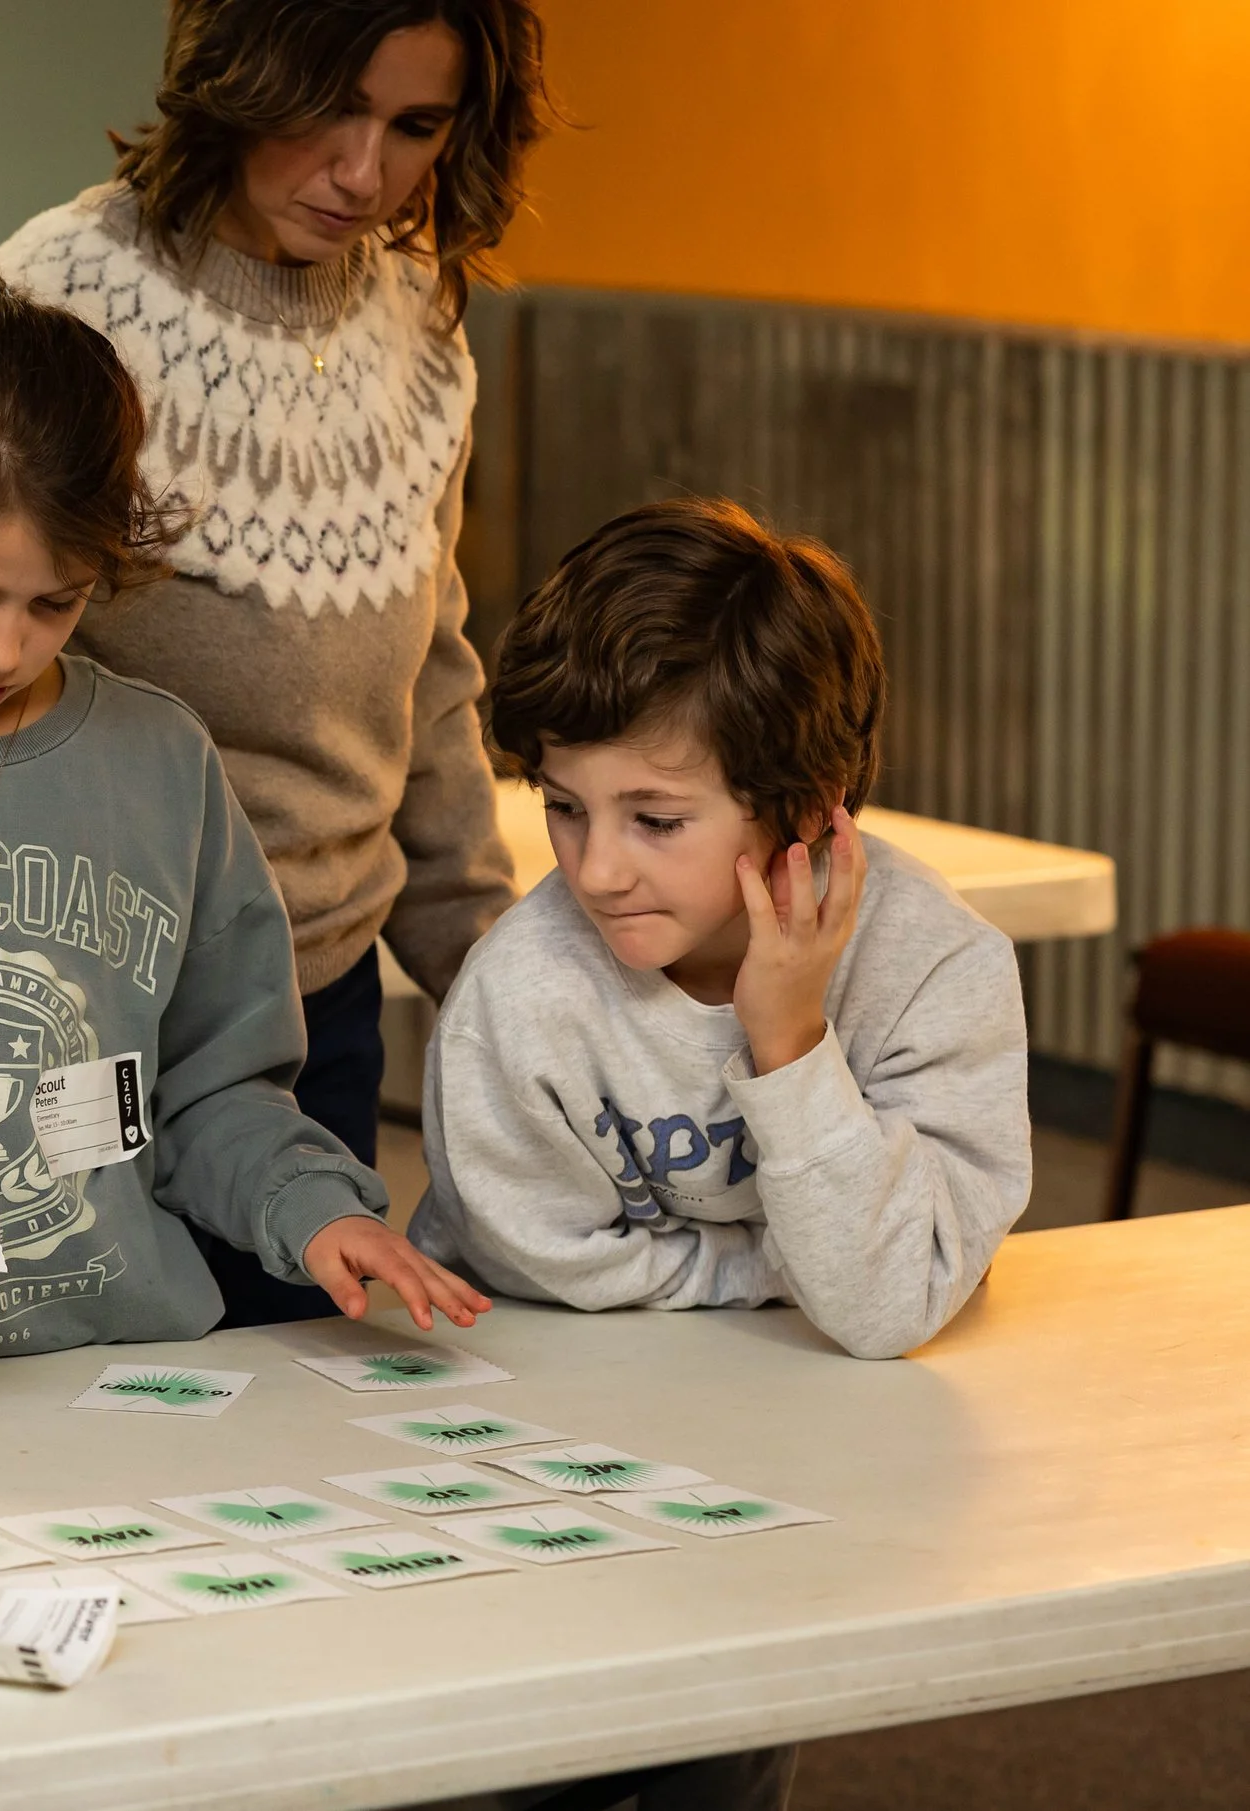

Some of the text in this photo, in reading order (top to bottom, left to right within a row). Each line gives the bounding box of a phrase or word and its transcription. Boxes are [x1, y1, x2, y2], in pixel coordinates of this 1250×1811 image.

[35, 1096, 58, 1109] Peters
[390, 1365, 433, 1375] IN
[99, 1383, 233, 1398] (JOHN 15:9)
[430, 1425, 504, 1439] YOU.
[426, 1489, 471, 1499] SO
[265, 1510, 285, 1521] I
[701, 1508, 743, 1519] AS
[67, 1528, 154, 1546] HAVE
[530, 1534, 597, 1548] THE
[345, 1554, 464, 1576] FATHER
[207, 1578, 276, 1594] HAS
